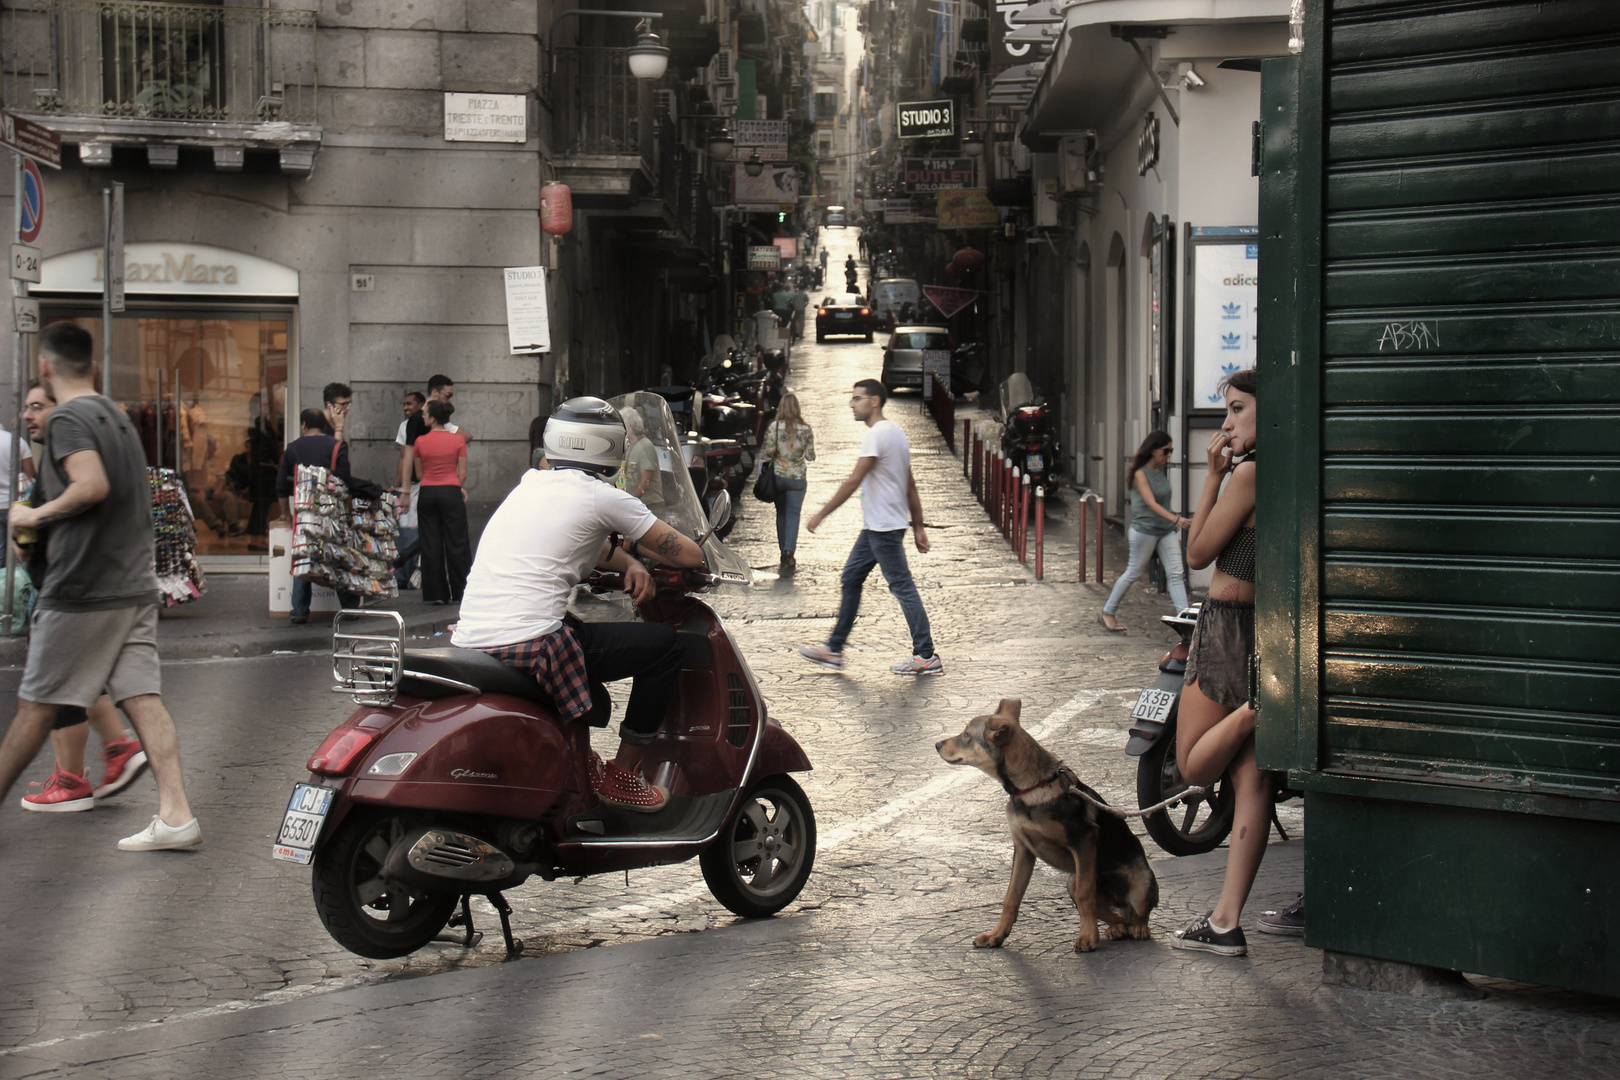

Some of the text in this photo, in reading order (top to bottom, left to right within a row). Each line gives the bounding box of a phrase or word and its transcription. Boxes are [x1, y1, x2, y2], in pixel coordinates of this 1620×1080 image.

[468, 99, 499, 110] PIAZZA
[447, 112, 483, 124] TRIESTE
[490, 114, 525, 126] TRENTO
[901, 108, 950, 126] STUDIO 3
[740, 121, 787, 132] FOTOCOPIE
[907, 170, 972, 183] OUTLET
[915, 183, 938, 191] SOLO
[508, 270, 542, 280] STUDIO 3
[924, 351, 950, 361] OUTLET
[1142, 691, 1170, 706] X3B
[1136, 704, 1165, 719] DVF
[299, 787, 320, 811] CJ
[282, 815, 320, 844] 65301
